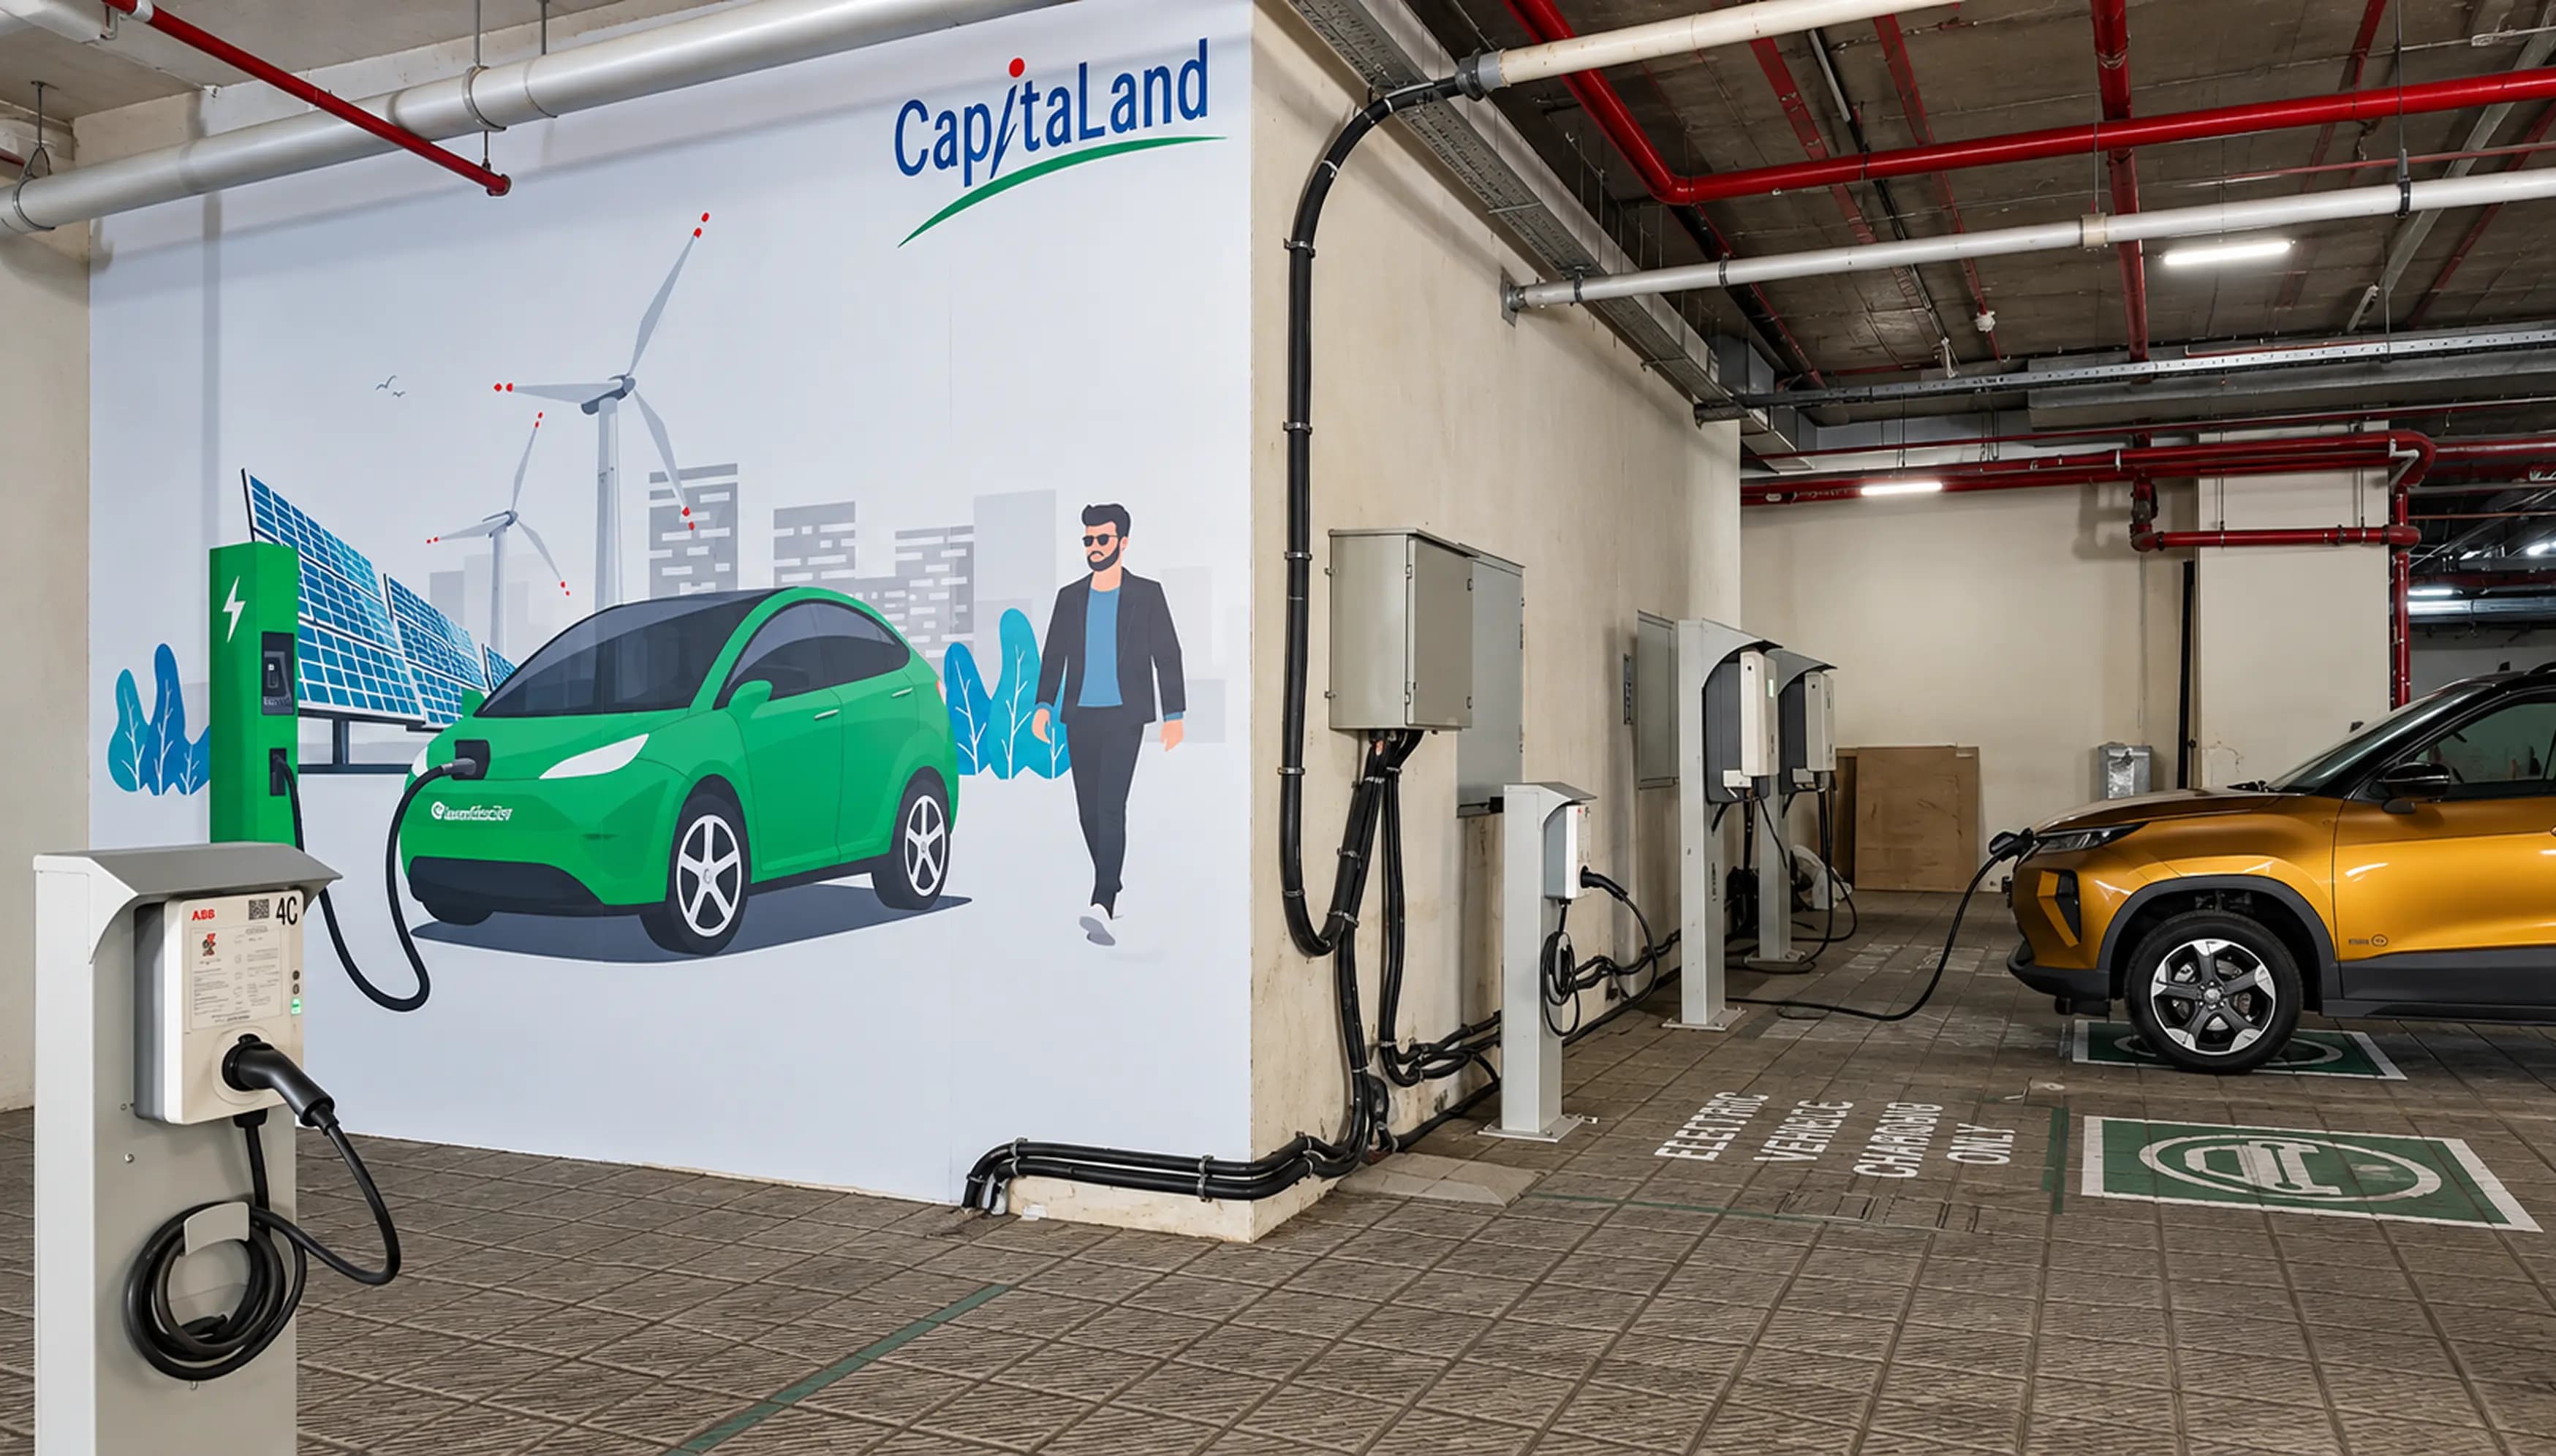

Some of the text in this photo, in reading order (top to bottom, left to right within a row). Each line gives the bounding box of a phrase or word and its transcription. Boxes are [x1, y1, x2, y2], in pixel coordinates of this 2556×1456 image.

[894, 37, 1209, 188] CapitaLand
[192, 909, 216, 921] ABB
[276, 896, 298, 926] 4C
[1946, 1123, 2016, 1165] ONLY
